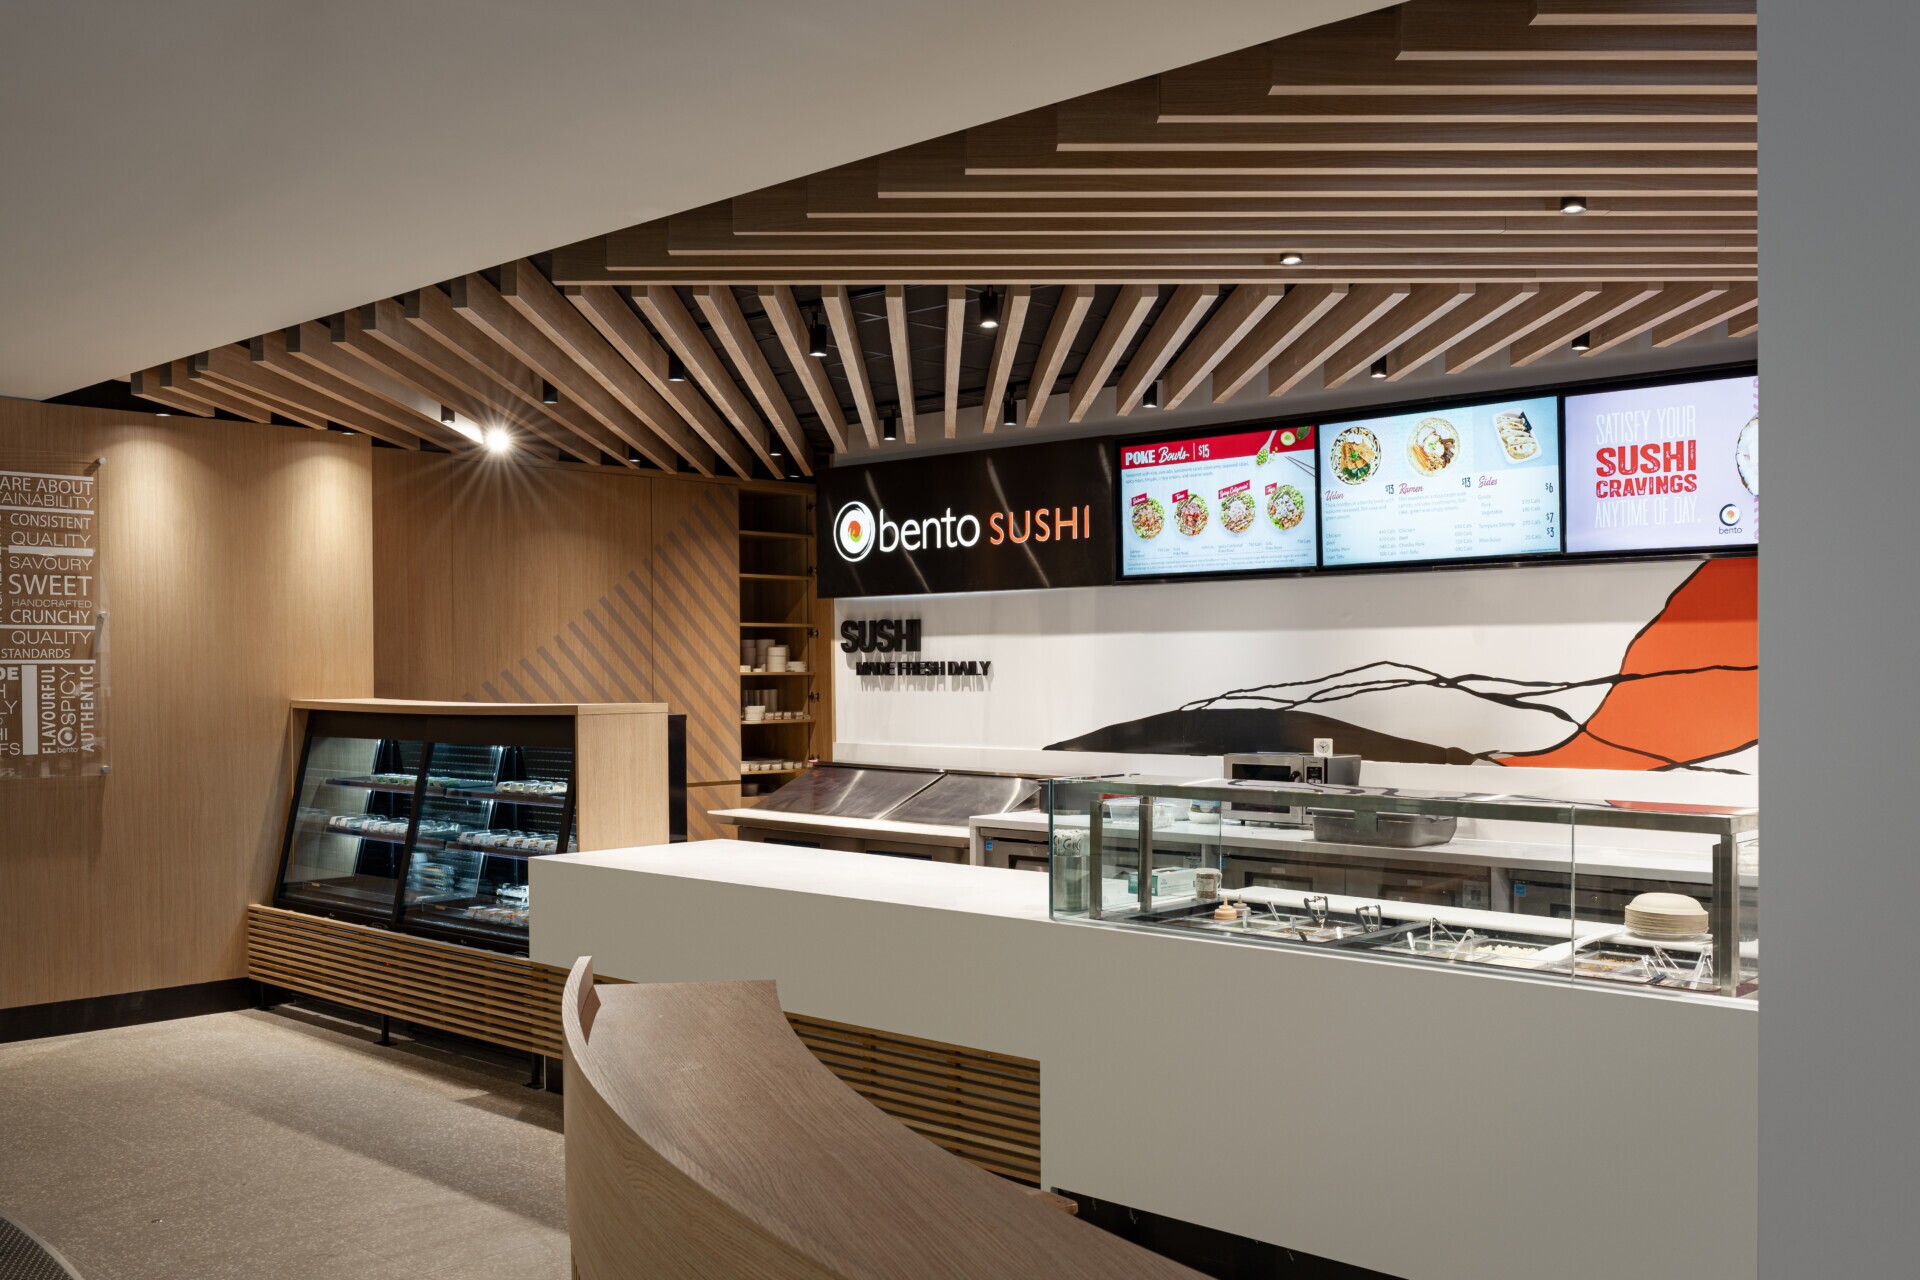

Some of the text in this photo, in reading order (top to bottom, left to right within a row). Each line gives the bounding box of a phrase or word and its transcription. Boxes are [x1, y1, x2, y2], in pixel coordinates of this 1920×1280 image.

[1596, 405, 1697, 445] SATISFY YOUR
[1125, 444, 1210, 466] POKE Bowls $15
[1596, 439, 1697, 477] SUSHI
[36, 478, 94, 496] ABOUT
[1399, 483, 1424, 494] Ramen
[1462, 477, 1471, 488] $13
[1478, 475, 1498, 488] Sides
[1545, 482, 1554, 493] $6
[1595, 473, 1697, 499] CRAVINGS
[1325, 490, 1344, 501] Udon
[1385, 484, 1394, 495] $13
[0, 491, 94, 509] AINABILITY
[1546, 512, 1554, 523] $7
[1595, 495, 1701, 529] ANYTIME OF DAY.
[10, 513, 91, 530] CONSISTENT
[879, 505, 1090, 552] bento SUSHI
[1546, 527, 1555, 538] $3
[1718, 526, 1743, 535] bento
[11, 531, 92, 548] QUALITY
[9, 556, 93, 571] SAVOURY
[8, 573, 93, 596] SWEET
[11, 599, 93, 609] HANDCRAFTED
[10, 609, 91, 624] CRUNCHY
[11, 630, 92, 645] QUALITY
[840, 619, 921, 654] SUSHI
[1, 648, 71, 659] STANDARDS
[856, 661, 992, 676] MADE FRESH DAILY
[60, 667, 77, 725] SPICY
[41, 666, 57, 755] FLAVOURFUL
[79, 666, 95, 753] AUTHENTIC
[57, 746, 79, 754] bento
